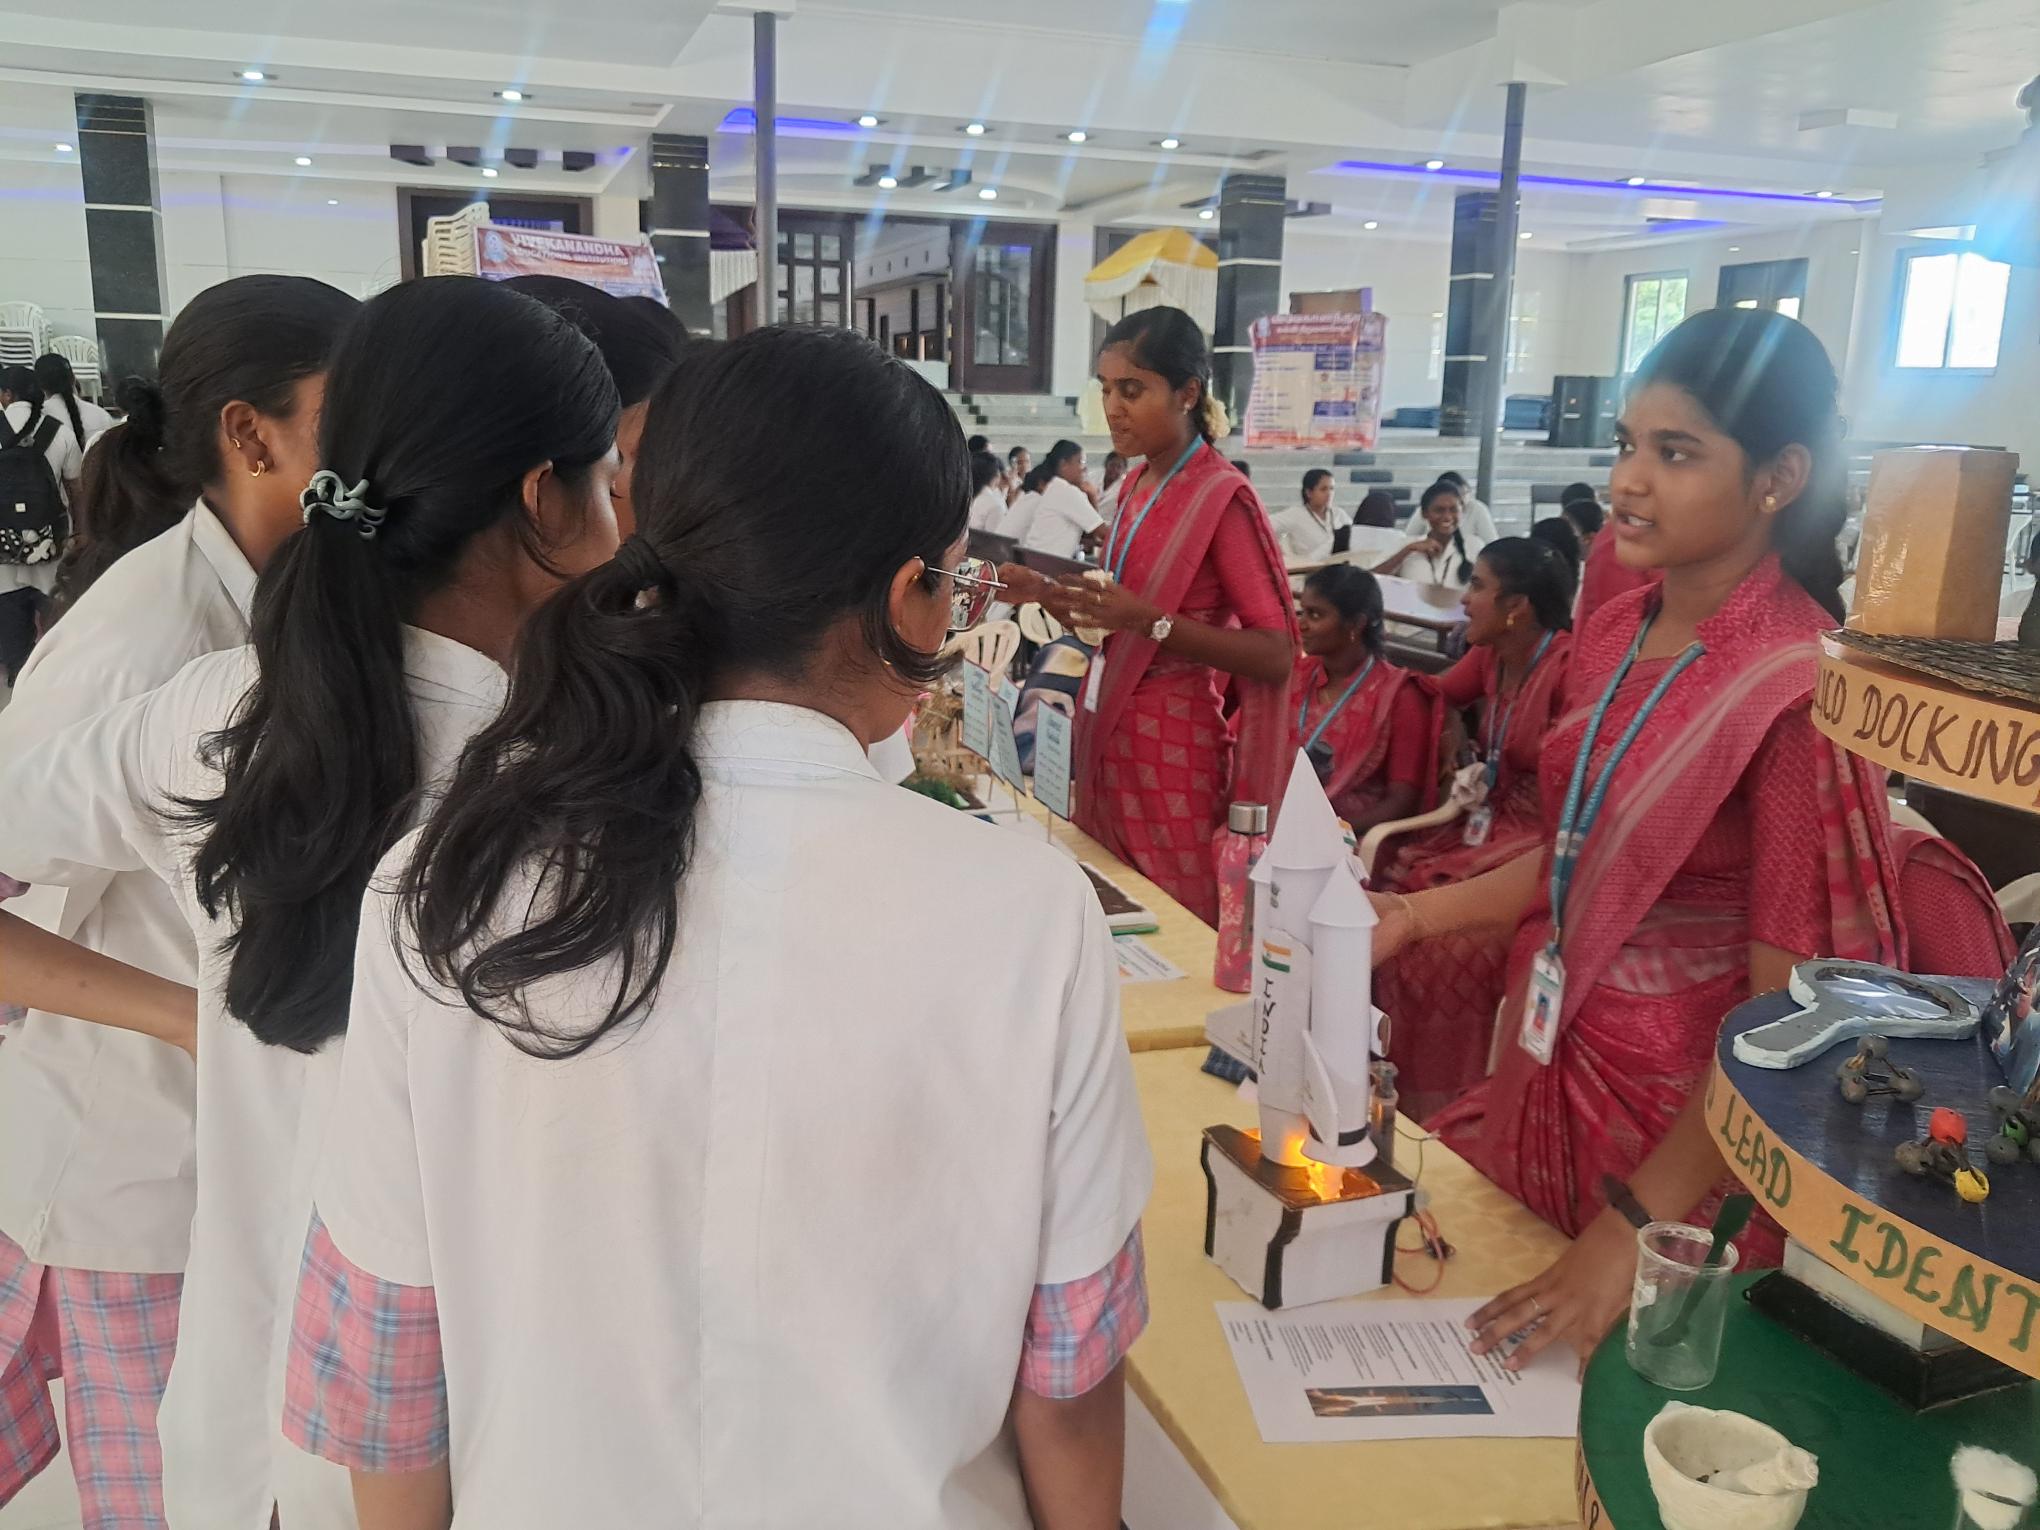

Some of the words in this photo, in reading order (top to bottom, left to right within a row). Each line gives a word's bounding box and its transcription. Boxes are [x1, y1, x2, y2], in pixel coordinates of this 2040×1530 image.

[511, 234, 624, 256] VIVEKANANDHA
[1853, 684, 2040, 787] DOCKING
[1720, 1093, 1792, 1208] LEAD
